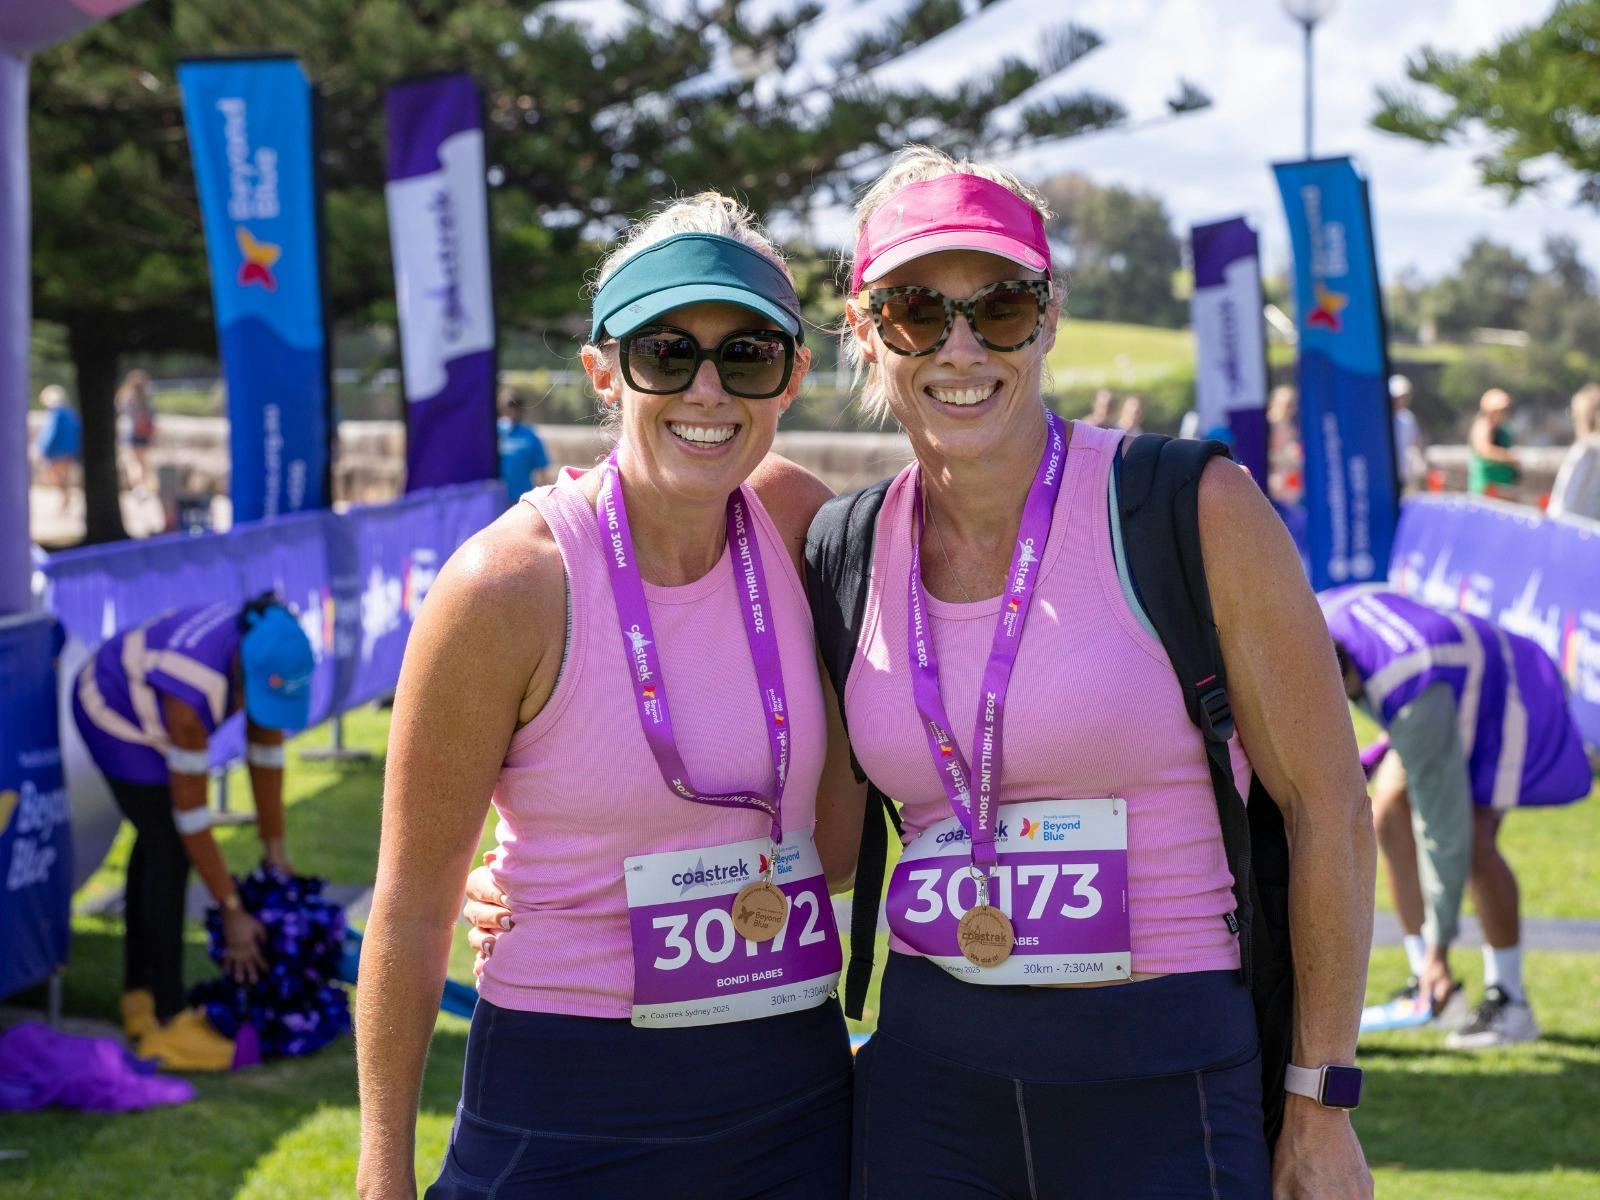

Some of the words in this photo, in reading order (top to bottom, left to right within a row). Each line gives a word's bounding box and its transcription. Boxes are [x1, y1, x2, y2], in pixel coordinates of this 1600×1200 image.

[1043, 452, 1060, 486] 30KM
[603, 490, 619, 530] ILLING
[611, 532, 628, 569] 30KM
[734, 502, 746, 537] 30KM
[738, 538, 760, 602] THRILLING
[1014, 538, 1034, 594] coastrek
[752, 603, 766, 634] 2025
[911, 573, 923, 638] THRILLING
[631, 624, 653, 682] coastrek
[916, 639, 928, 668] 2025
[985, 691, 997, 722] 2025
[980, 725, 994, 792] THRILLING
[978, 795, 990, 830] 30KM
[1043, 820, 1081, 832] Beyond
[1043, 831, 1065, 841] Blue
[775, 850, 800, 864] Beyond
[777, 864, 793, 874] Blue
[671, 858, 750, 886] coastrek
[904, 863, 1103, 923] 30173
[652, 890, 826, 970] 3072
[753, 919, 769, 929] Blue
[755, 911, 783, 923] Beyond
[961, 931, 1007, 943] coastrek
[1013, 936, 1039, 946] ABES
[716, 975, 750, 988] BONDI
[752, 968, 784, 982] BABES
[964, 966, 981, 974] 2025
[1023, 963, 1053, 974] 30km
[1063, 962, 1104, 973] 7:30AM
[770, 993, 797, 1006] 30km
[803, 984, 830, 999] 7:30AM
[650, 1009, 683, 1020] Coastrek
[685, 1007, 711, 1019] Sydney
[712, 1004, 730, 1014] 2025
